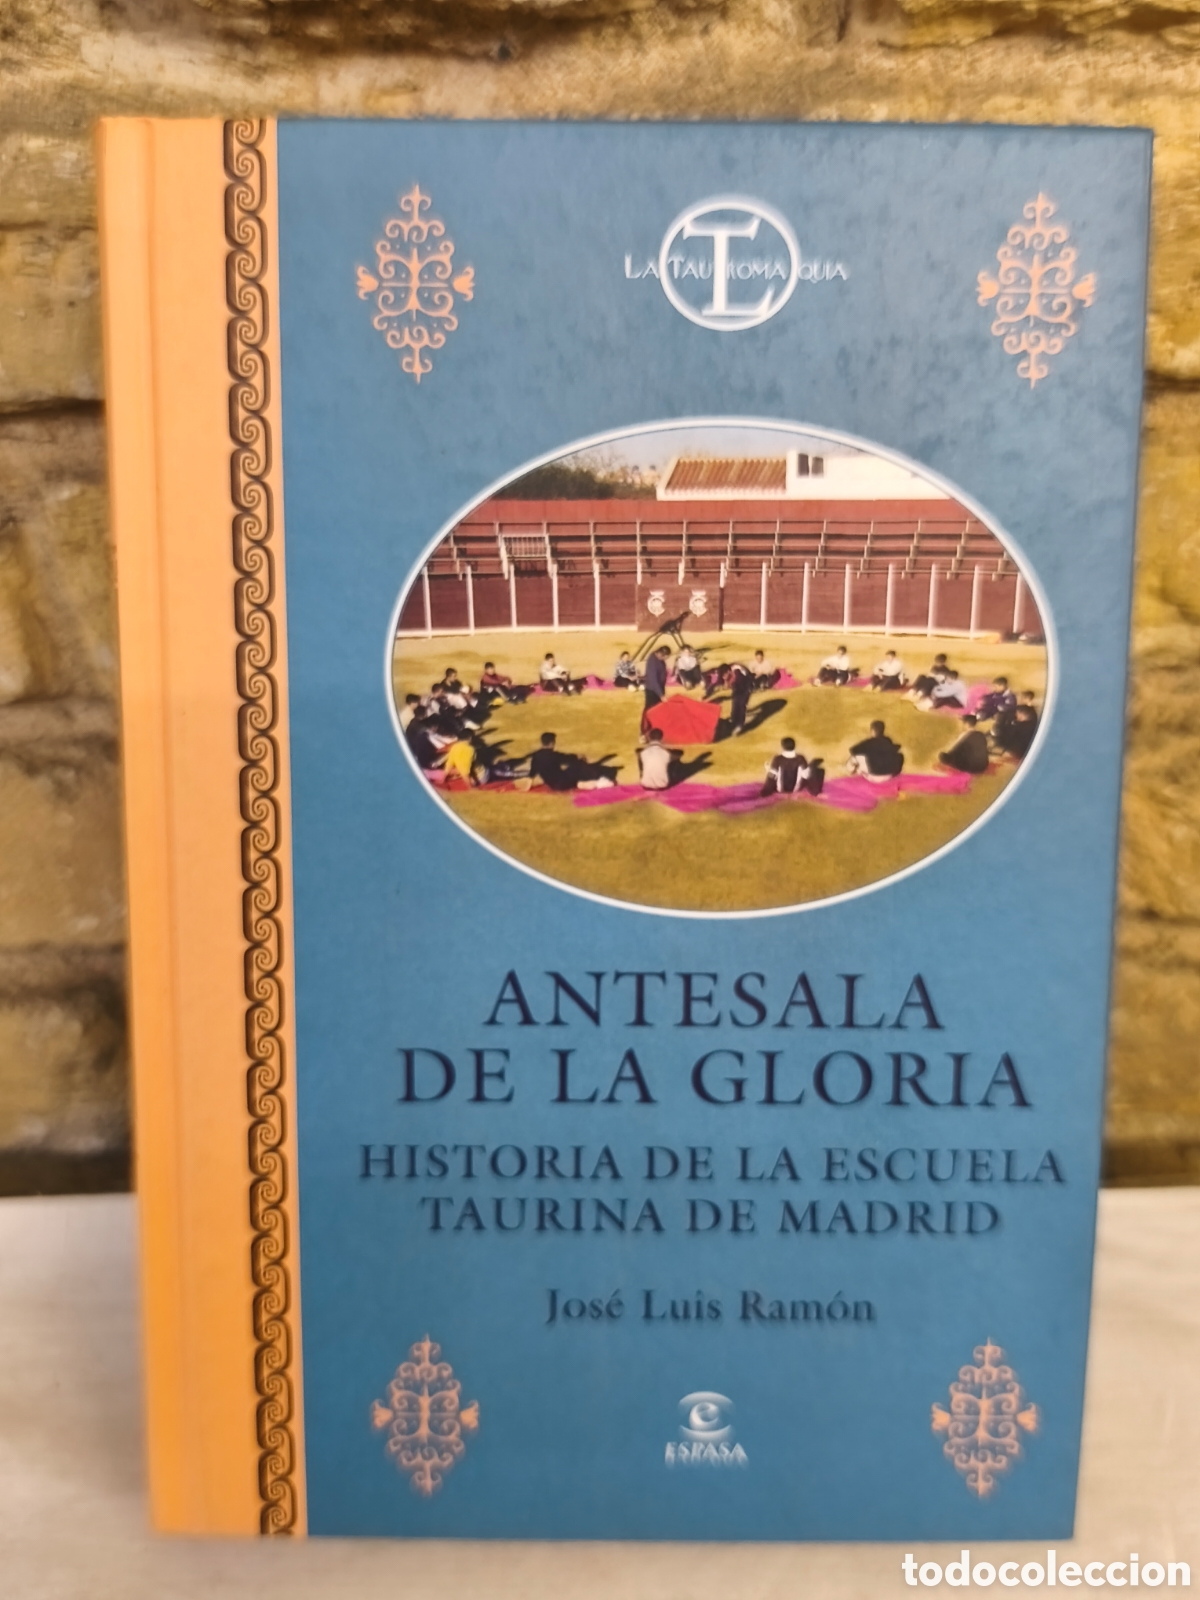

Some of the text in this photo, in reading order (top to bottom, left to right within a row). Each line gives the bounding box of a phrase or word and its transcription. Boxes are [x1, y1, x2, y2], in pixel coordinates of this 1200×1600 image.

[482, 969, 945, 1031] ANTESALA
[397, 1048, 1034, 1108] DE LA GLORIA
[359, 1143, 1067, 1185] HISTORIA DE LA ESCUELA
[421, 1196, 1002, 1236] TAURINA DE MADRID
[545, 1288, 876, 1326] José Luis Ramón
[664, 1441, 749, 1466] ESPASA
